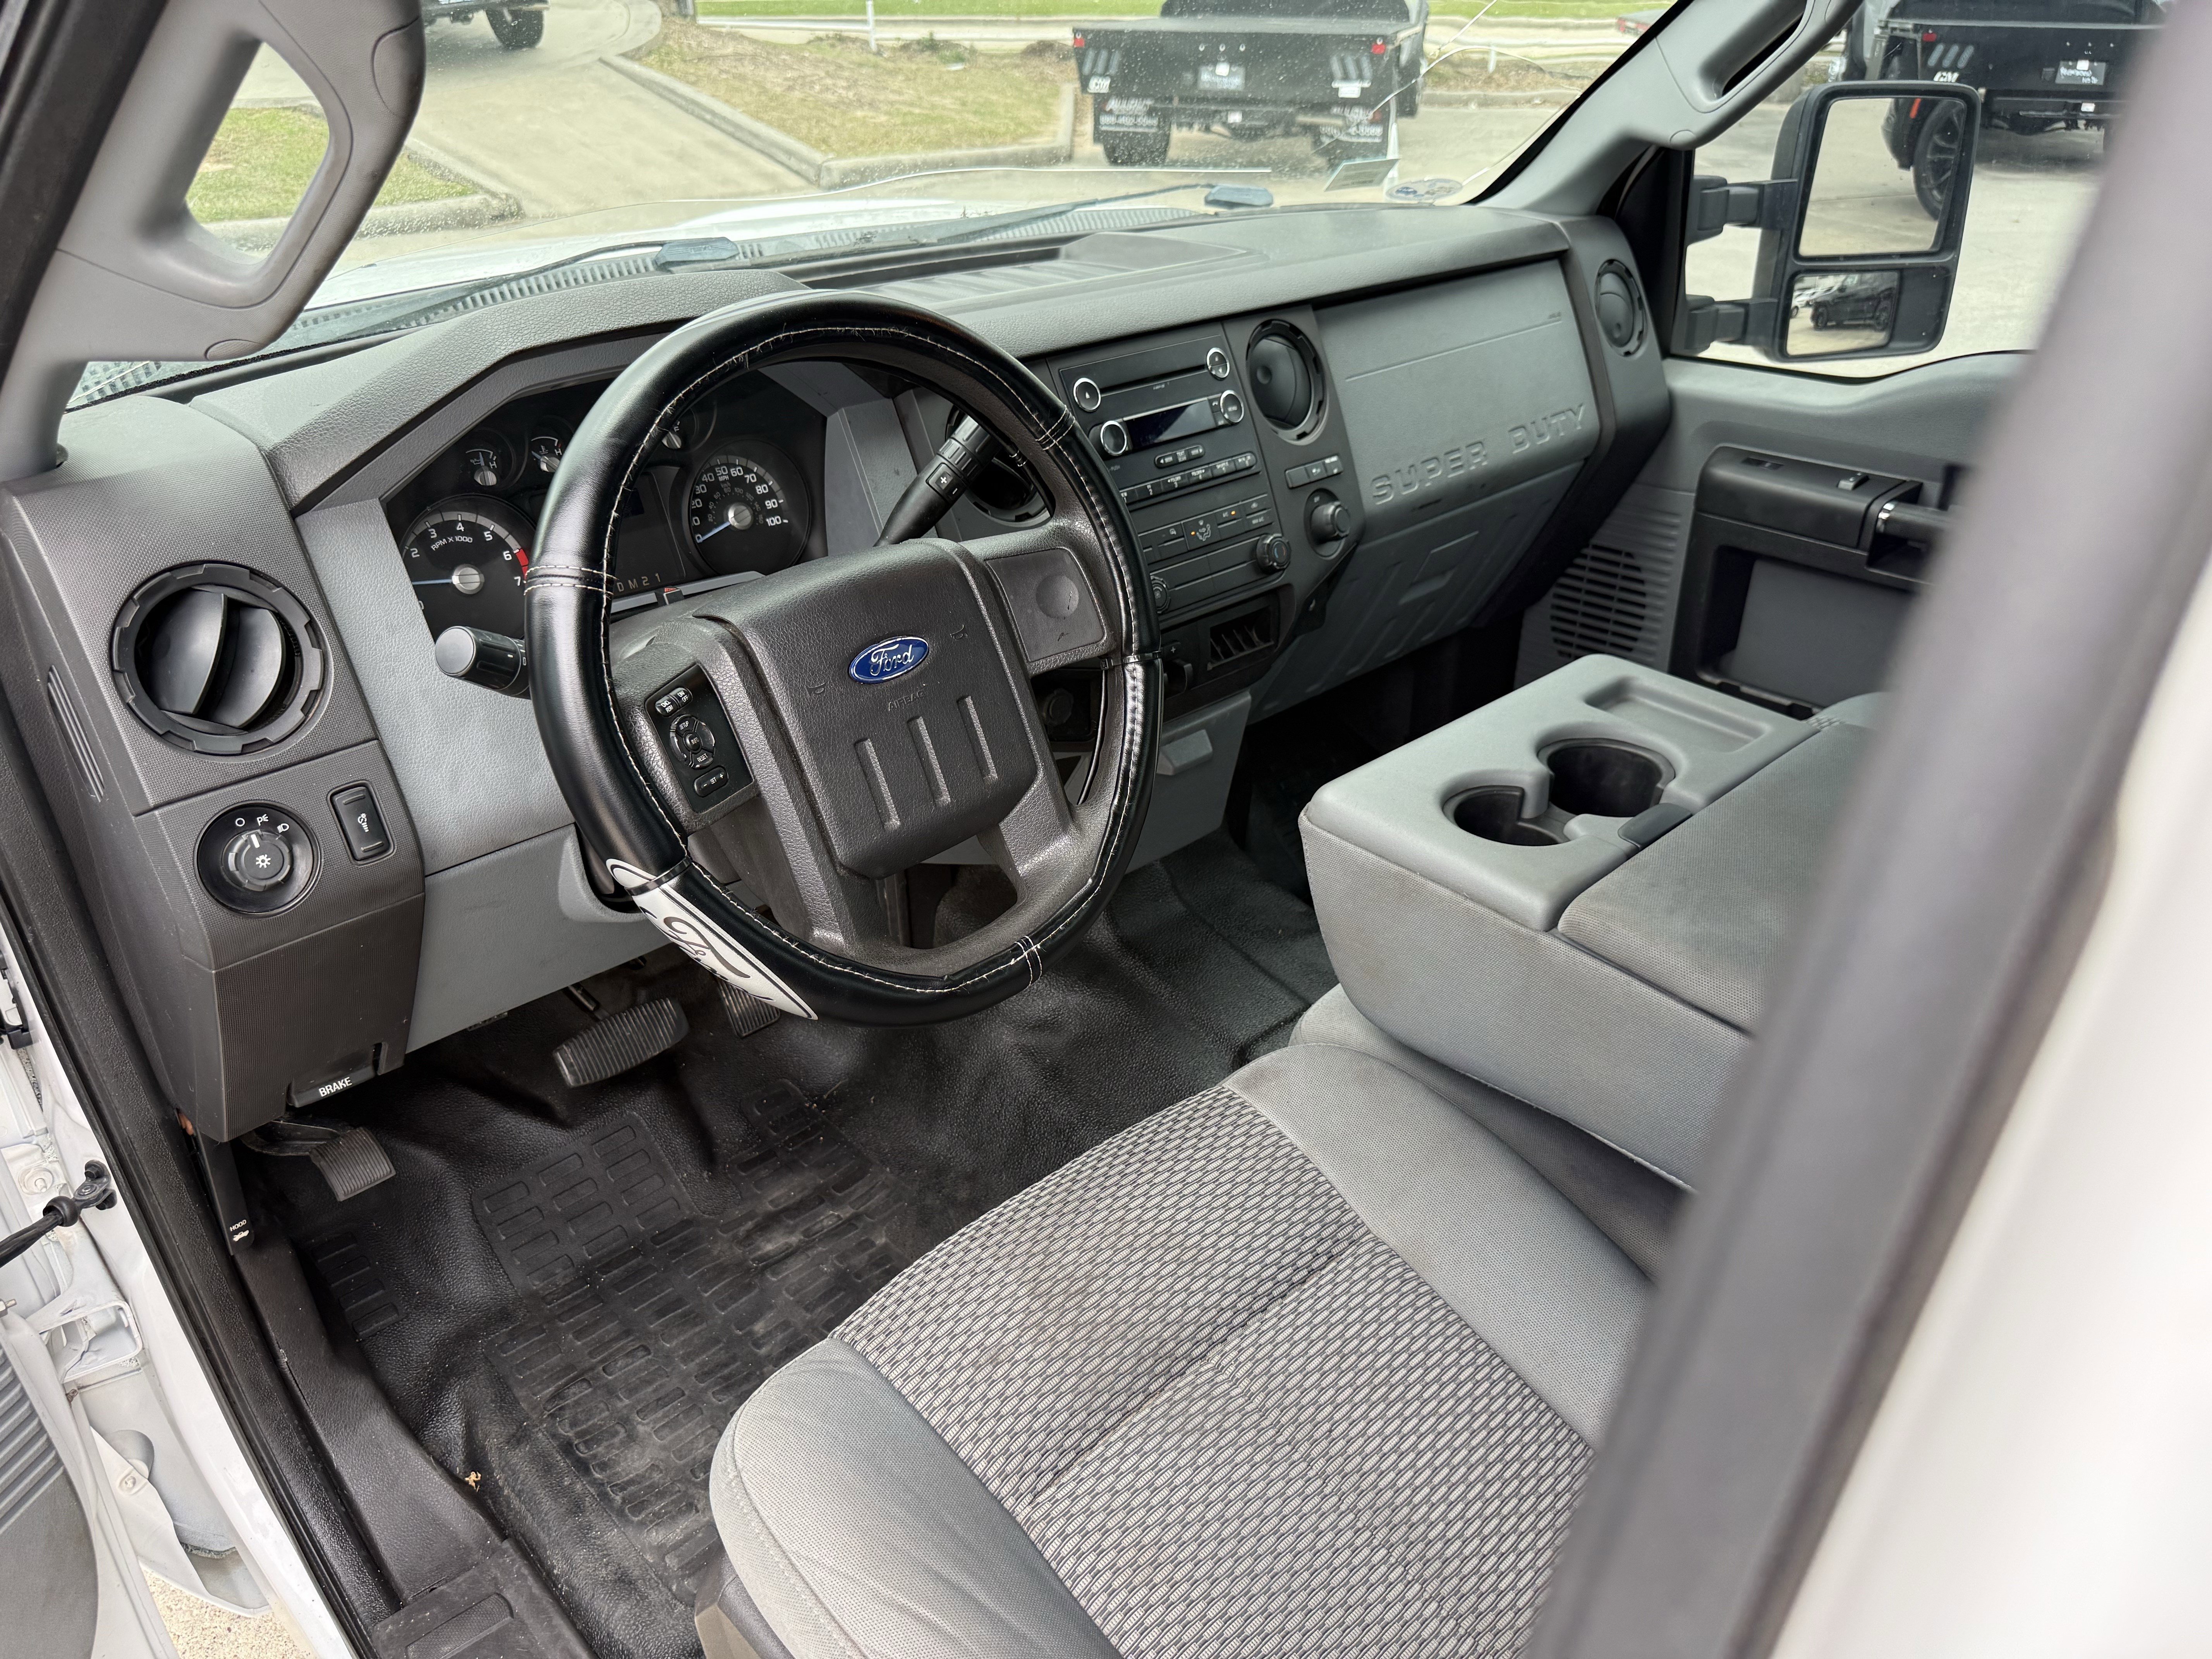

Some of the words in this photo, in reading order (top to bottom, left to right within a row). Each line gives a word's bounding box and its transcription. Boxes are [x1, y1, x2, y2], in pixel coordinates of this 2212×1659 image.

[1371, 439, 1488, 505] SUPER
[1508, 403, 1585, 454] DUTY
[715, 466, 728, 476] 50
[730, 467, 744, 477] 60
[702, 473, 714, 482] 40
[744, 473, 757, 483] 70
[756, 484, 769, 494] 80
[765, 499, 778, 509] 90
[766, 515, 781, 526] 100
[457, 523, 464, 532] 4
[428, 529, 437, 538] 3
[484, 531, 493, 541] 5
[431, 539, 447, 551] RPM
[410, 548, 420, 558] 2
[503, 551, 512, 561] 6
[514, 576, 521, 586] 7
[869, 644, 914, 676] Ford
[679, 721, 689, 730] SETUP
[697, 753, 708, 763] RESET
[318, 1077, 352, 1097] BRAKE
[230, 1219, 247, 1232] HOOD
